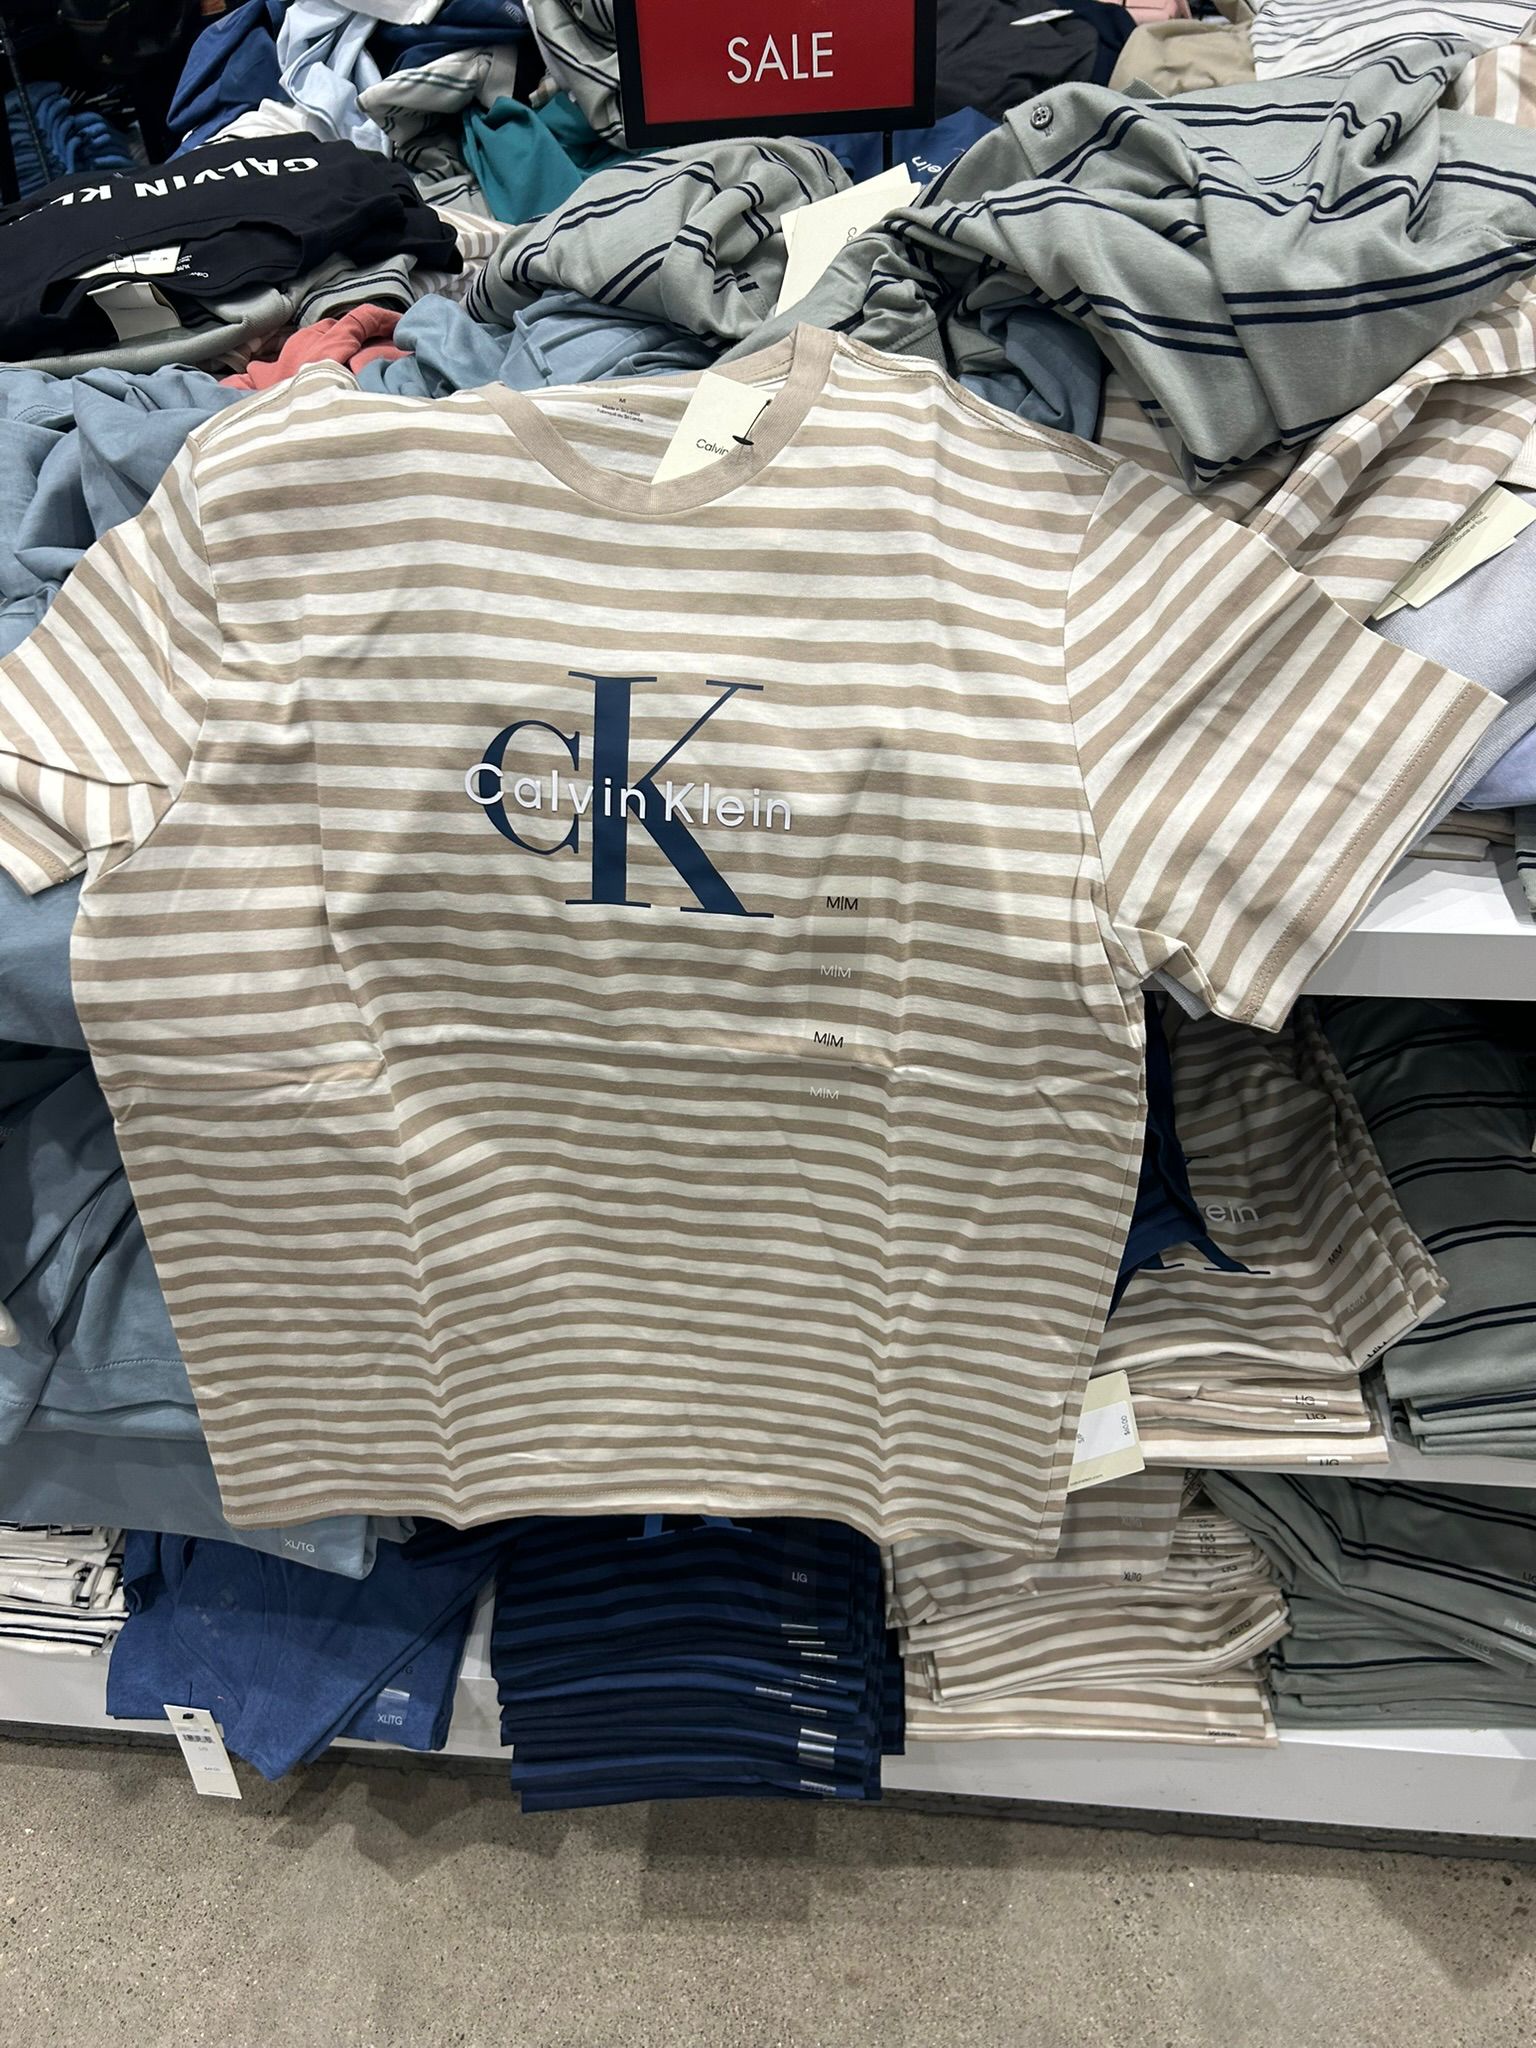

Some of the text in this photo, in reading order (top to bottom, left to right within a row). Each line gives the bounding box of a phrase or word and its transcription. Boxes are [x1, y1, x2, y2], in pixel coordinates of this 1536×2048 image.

[727, 31, 834, 84] SALE
[134, 157, 319, 197] CALVIN
[911, 156, 942, 173] ein
[464, 763, 792, 831] Calvin Klein
[1205, 1200, 1259, 1224] ein
